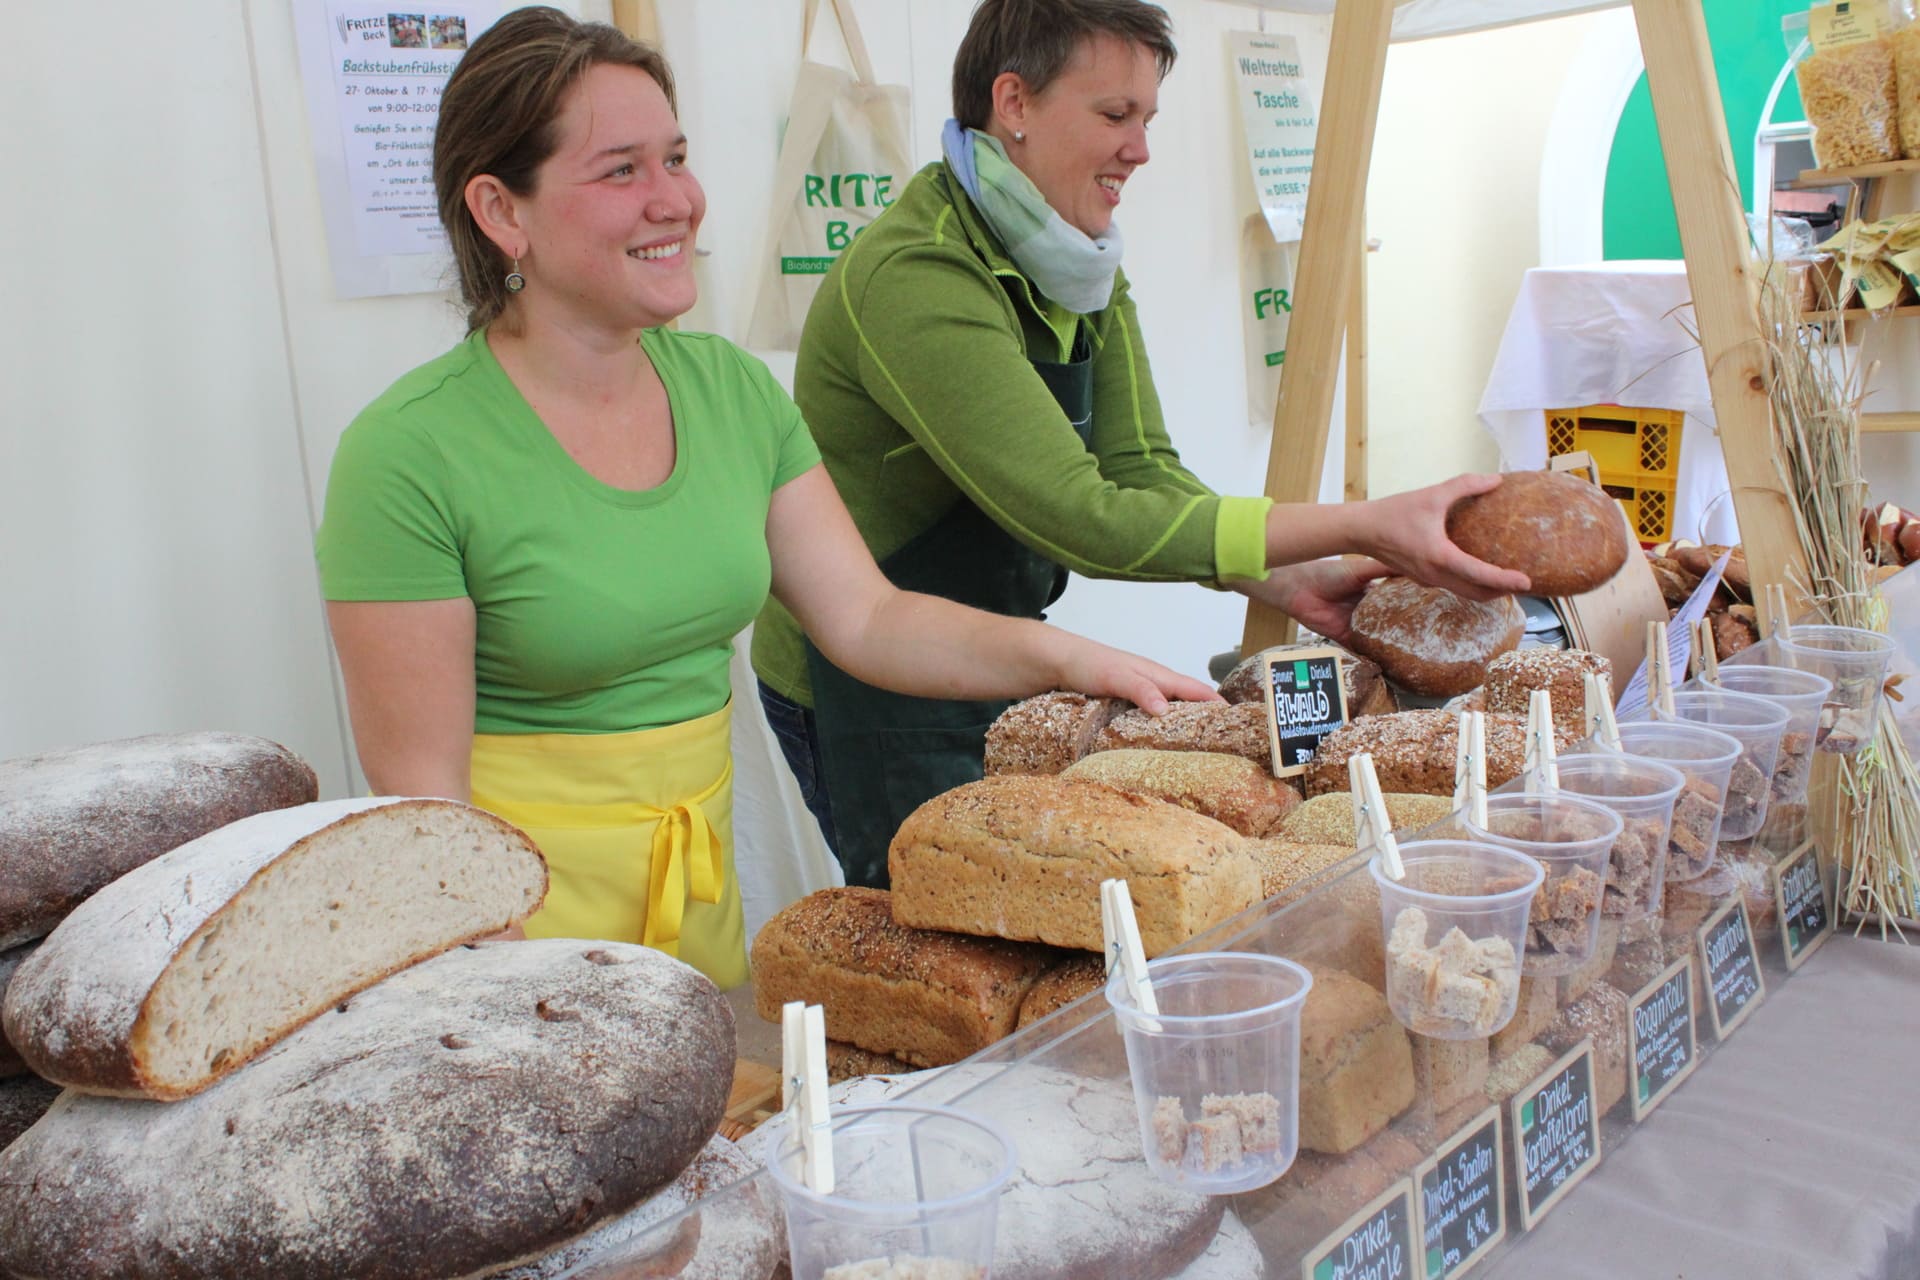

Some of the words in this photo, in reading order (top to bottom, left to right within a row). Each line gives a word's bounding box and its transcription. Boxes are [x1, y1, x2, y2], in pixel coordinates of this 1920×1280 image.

[346, 17, 386, 31] FRITZE
[363, 31, 386, 41] Beck
[1239, 57, 1300, 77] Weltretter
[364, 86, 399, 96] Oktober
[401, 87, 408, 96] &
[1253, 91, 1300, 109] Tasche
[368, 105, 383, 113] von
[354, 123, 391, 134] Genießen
[395, 124, 407, 133] Sie
[390, 177, 418, 185] unserer
[1273, 183, 1300, 195] DIESE
[787, 260, 822, 270] Bioland
[1310, 664, 1332, 680] Dinkel
[1275, 690, 1330, 726] EWALD
[1539, 1070, 1575, 1124] Dinkel-
[1525, 1092, 1588, 1176] Kartoffelbrot
[1423, 1144, 1492, 1222] Dinkel-Saaten
[1344, 1209, 1397, 1274] Dinkel-
